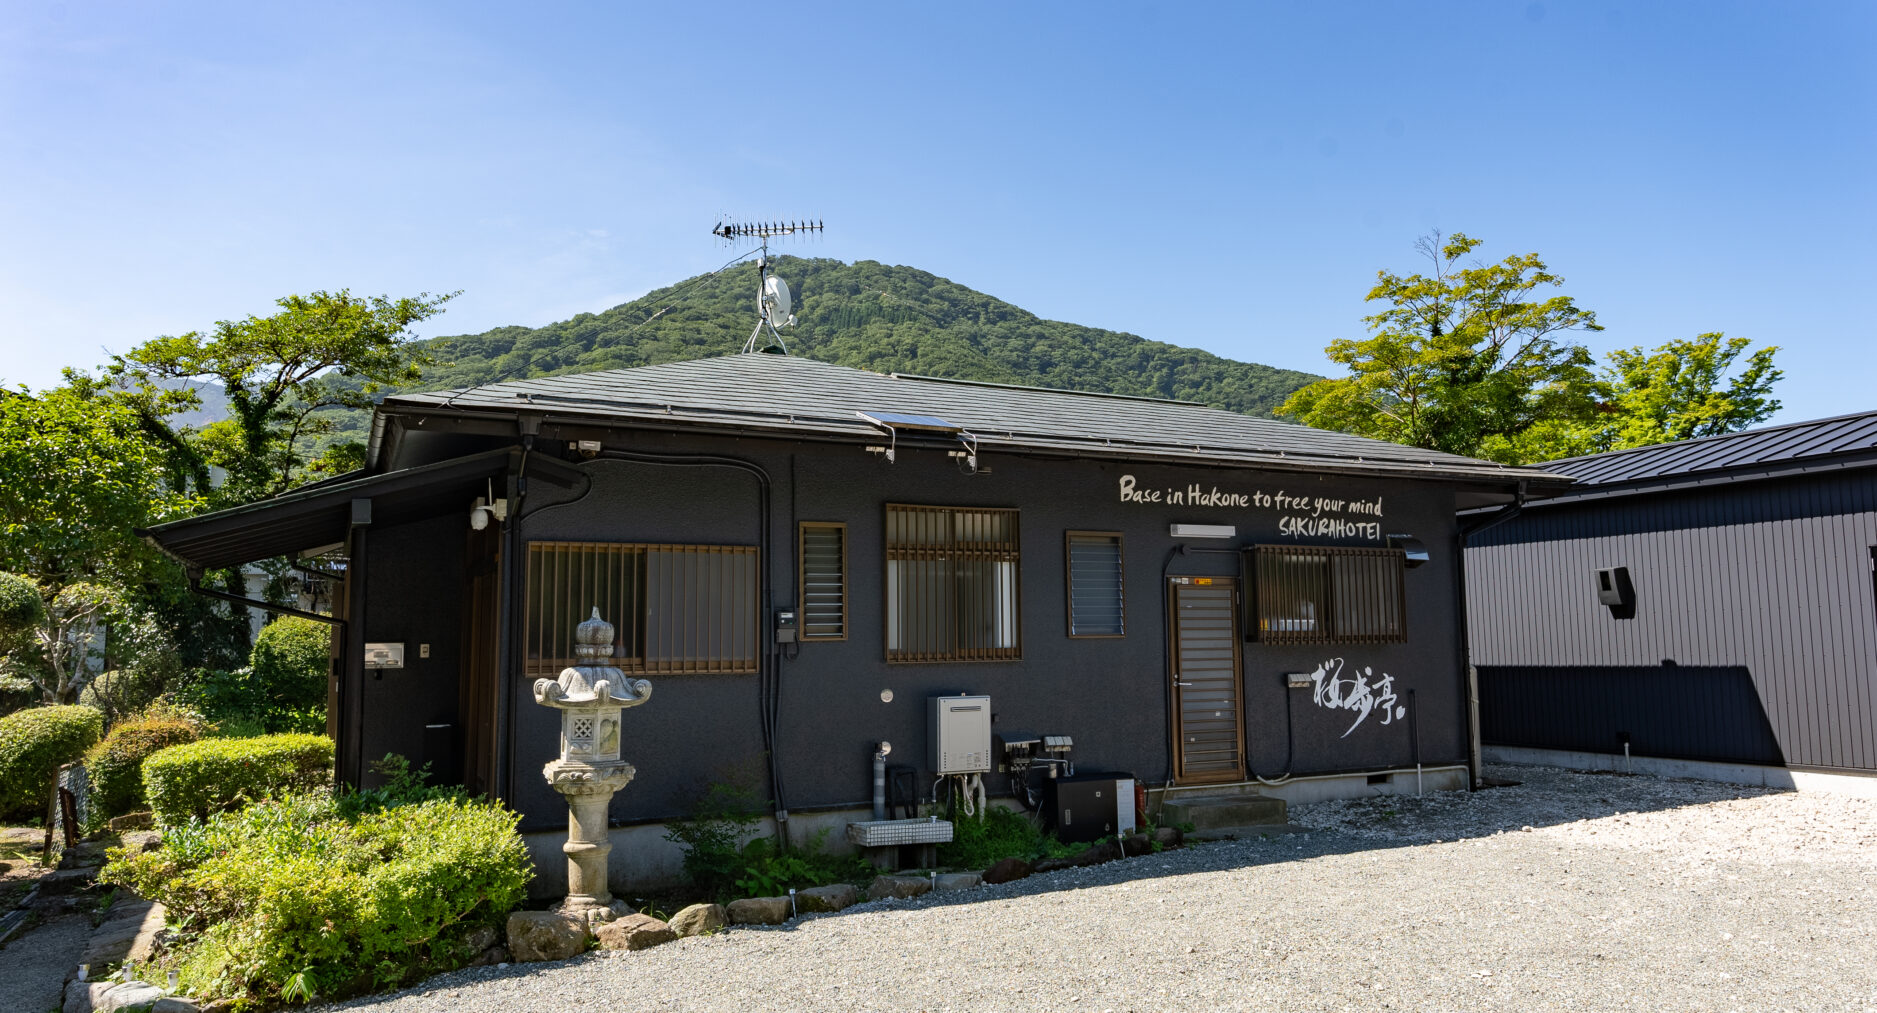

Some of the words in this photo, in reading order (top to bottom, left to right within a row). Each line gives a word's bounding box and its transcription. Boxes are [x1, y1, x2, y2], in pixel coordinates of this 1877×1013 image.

[1119, 474, 1163, 504] Base
[1166, 487, 1184, 506] in
[1188, 483, 1250, 508] Hakone
[1252, 490, 1271, 508] to
[1274, 490, 1311, 511] free
[1312, 497, 1346, 518] your
[1348, 496, 1383, 518] mind
